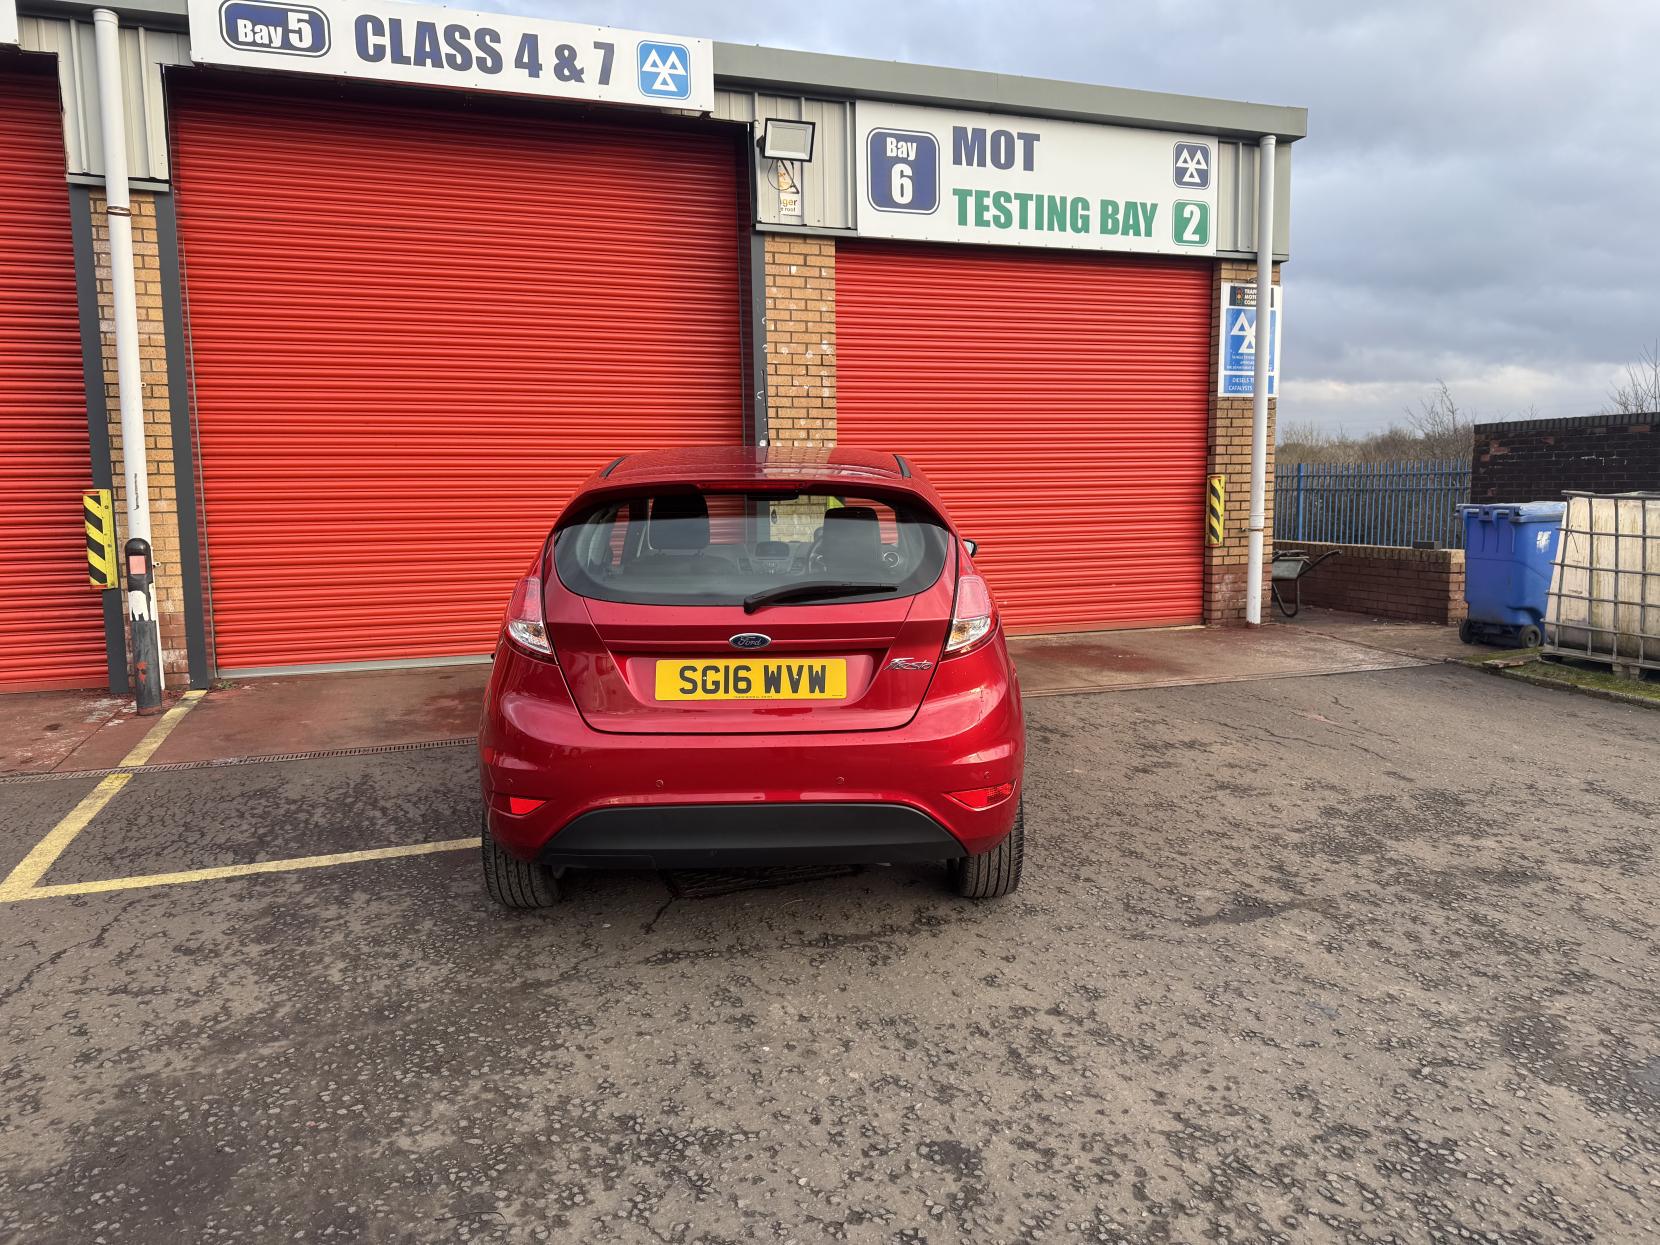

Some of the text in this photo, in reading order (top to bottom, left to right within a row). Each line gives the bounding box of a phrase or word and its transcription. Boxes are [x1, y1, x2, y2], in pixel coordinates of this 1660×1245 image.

[237, 12, 313, 49] Bay 5
[355, 14, 615, 86] CLASS 4 & 7
[886, 137, 917, 161] Bay
[953, 126, 1041, 172] MOT
[891, 163, 913, 205] 6
[780, 199, 797, 207] ger
[952, 188, 1158, 238] TESTING BAY
[1182, 204, 1201, 242] 2
[738, 635, 762, 646] Ford
[679, 664, 827, 694] SG16 WVW
